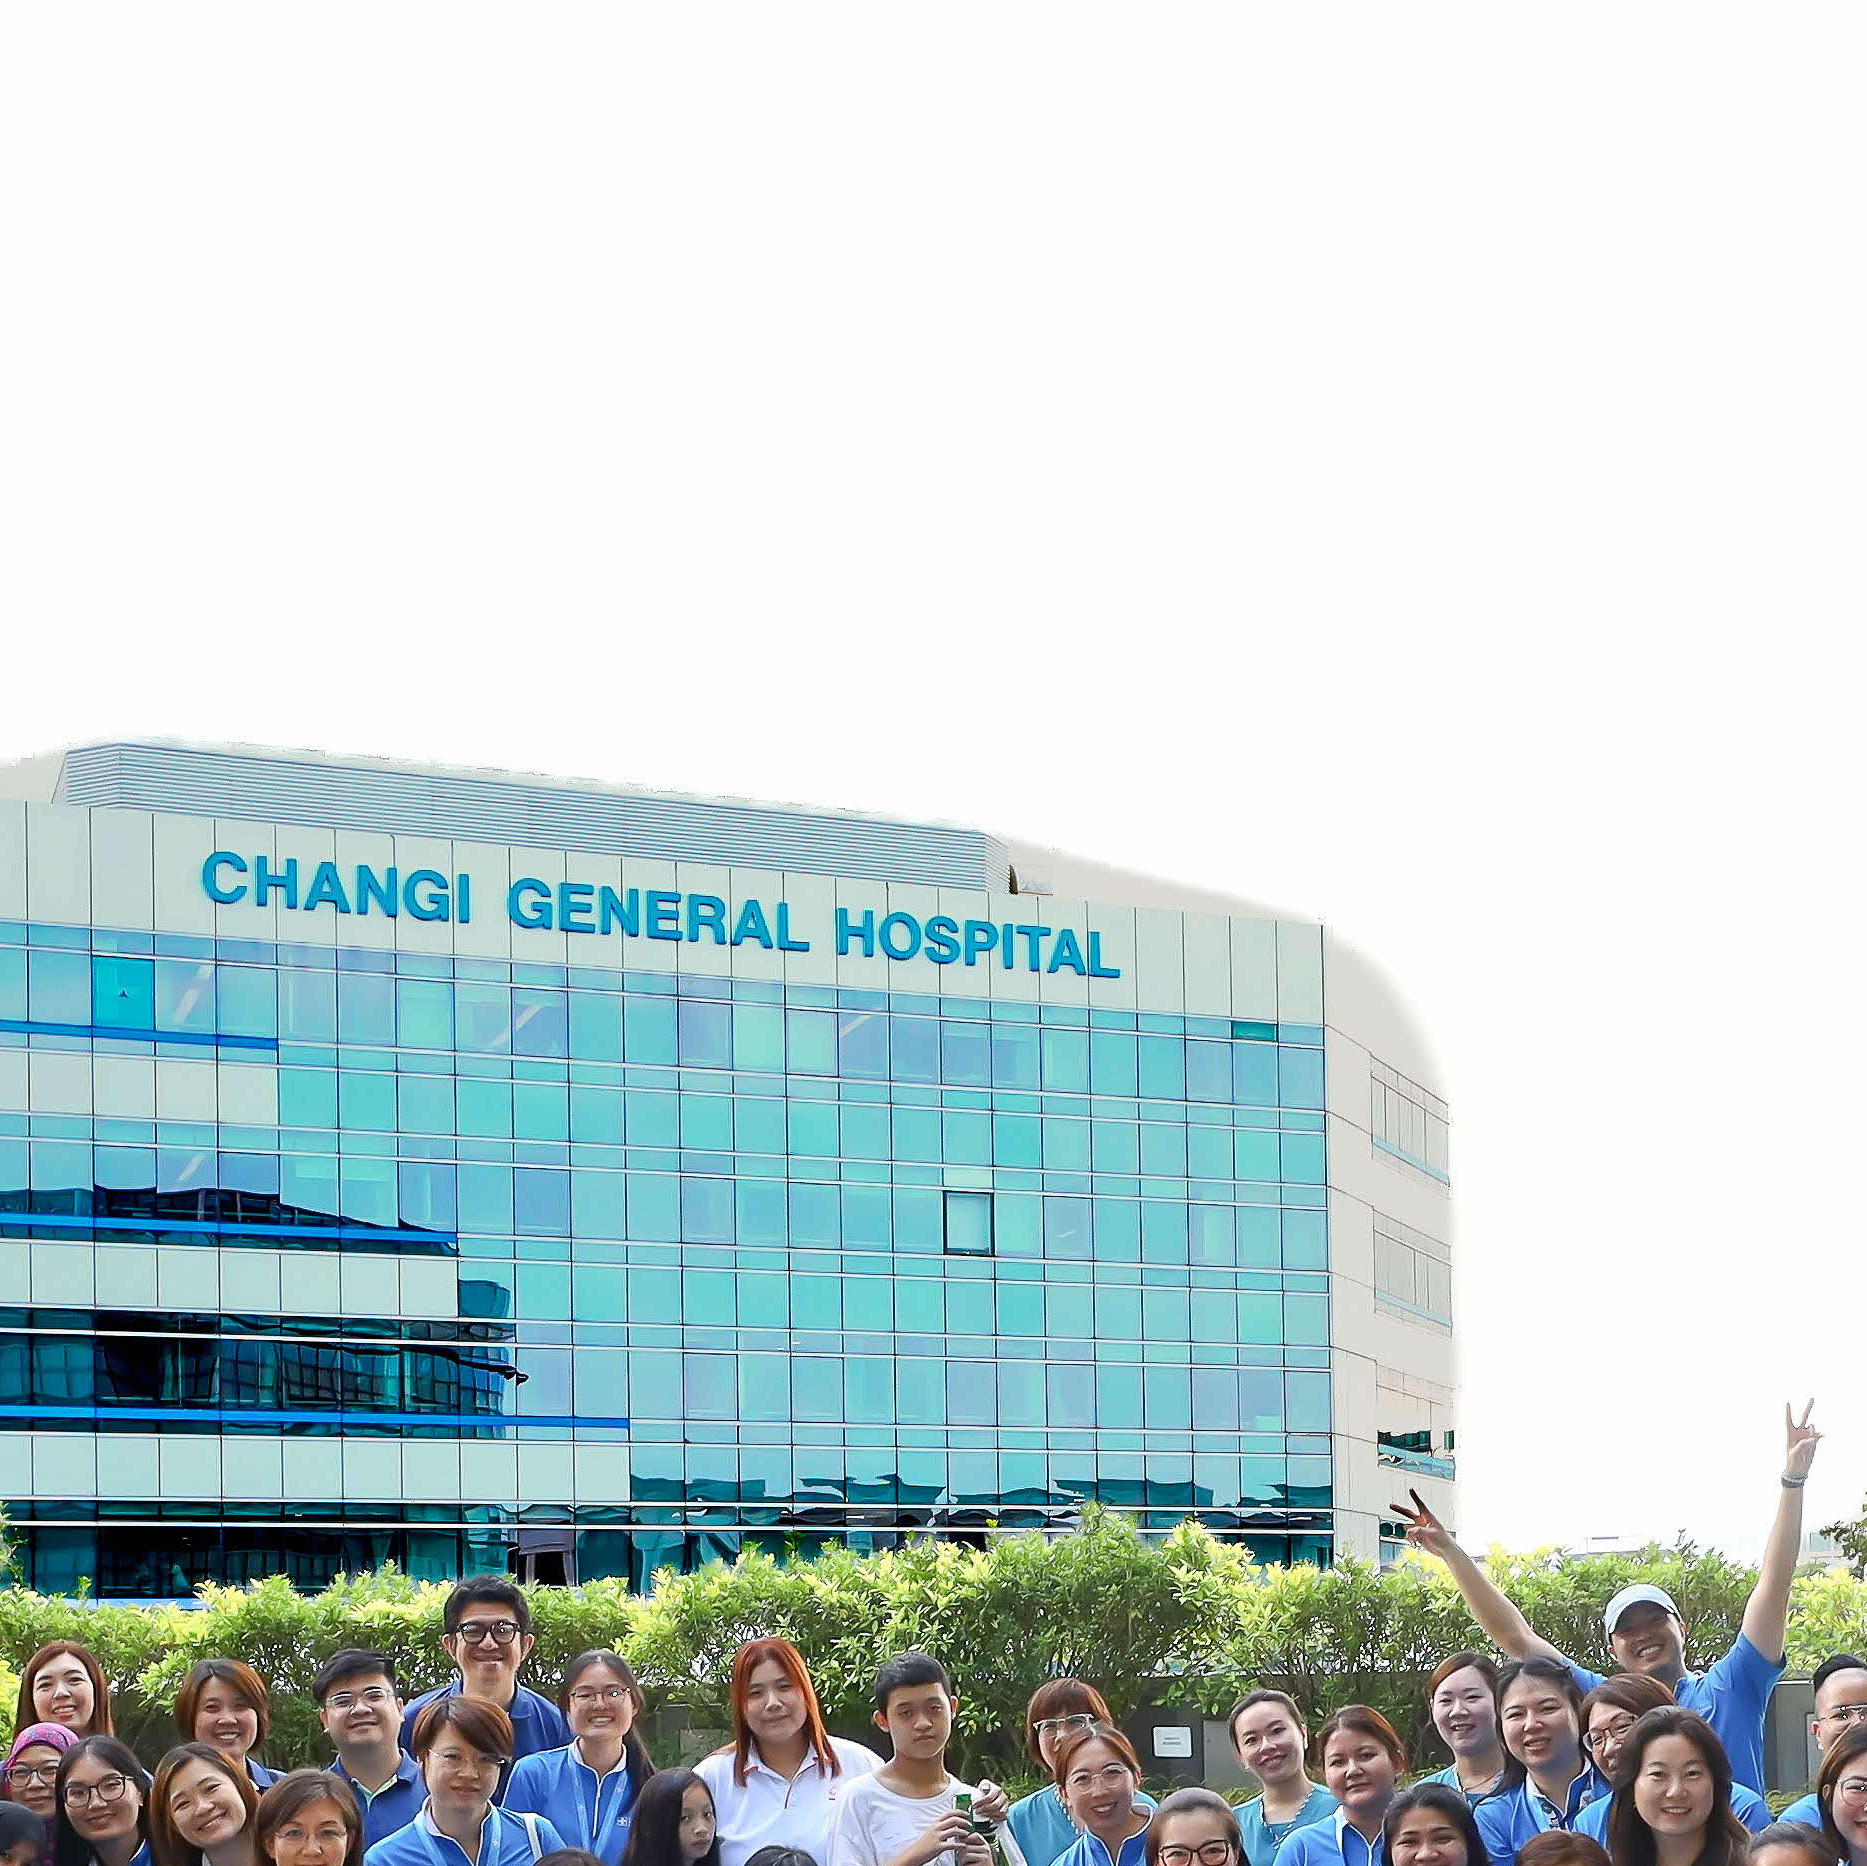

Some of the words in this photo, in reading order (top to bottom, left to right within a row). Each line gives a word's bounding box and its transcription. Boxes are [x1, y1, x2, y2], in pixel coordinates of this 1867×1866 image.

[200, 850, 471, 925] CHANGI
[505, 876, 812, 952] GENERAL
[833, 906, 1122, 979] HOSPITAL
